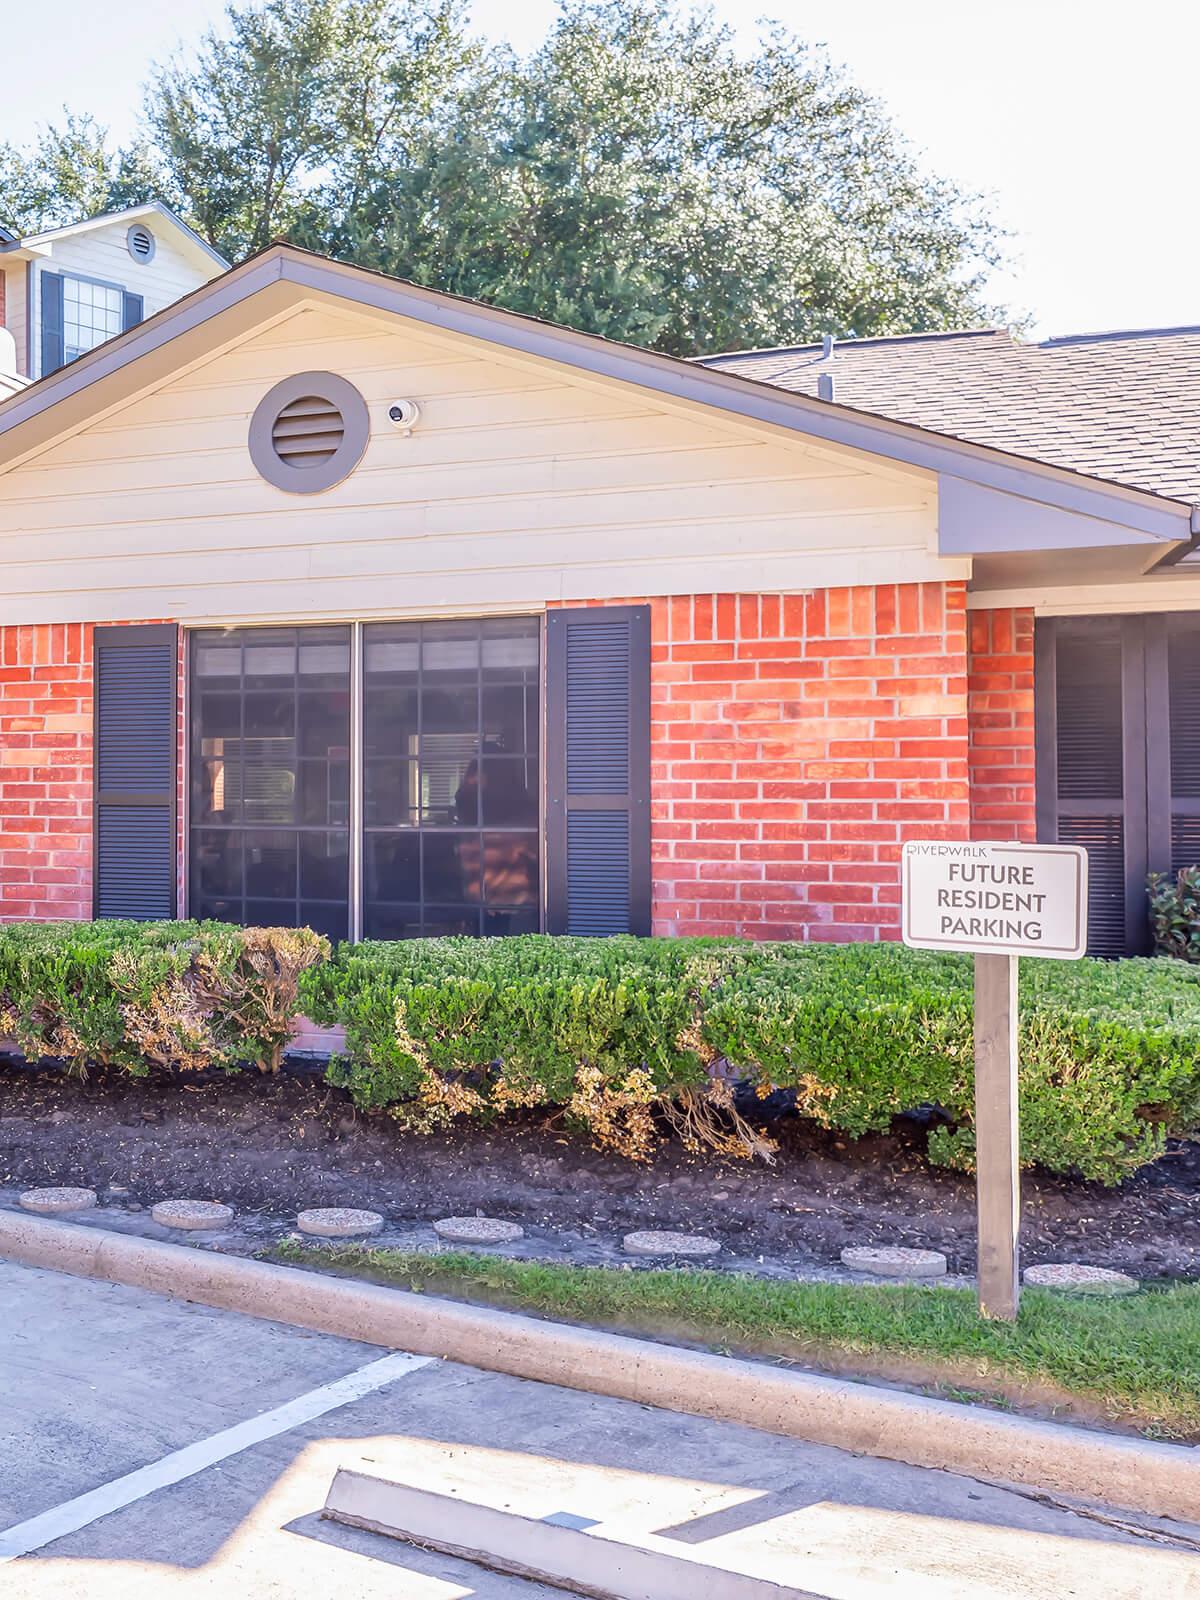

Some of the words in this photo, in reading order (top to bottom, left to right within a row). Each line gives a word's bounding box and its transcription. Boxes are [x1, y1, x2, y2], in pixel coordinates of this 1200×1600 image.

[906, 844, 988, 858] RIVERWALK
[948, 863, 1035, 886] FUTURE
[937, 888, 1046, 913] RESIDENT
[940, 915, 1042, 940] PARKING
